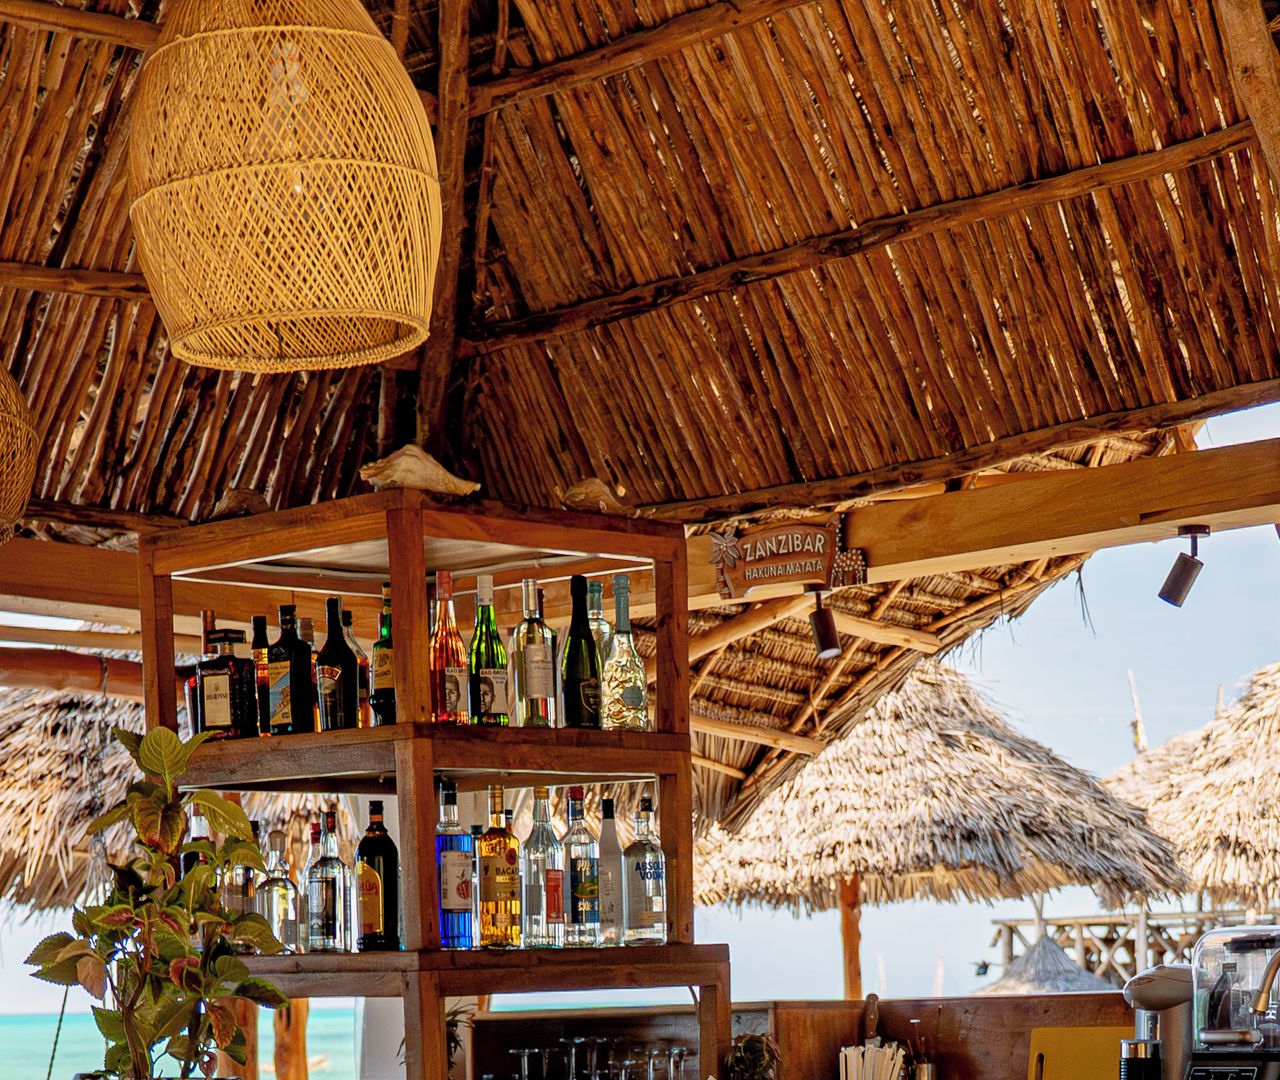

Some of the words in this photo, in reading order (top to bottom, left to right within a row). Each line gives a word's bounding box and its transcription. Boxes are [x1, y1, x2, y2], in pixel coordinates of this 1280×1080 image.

[743, 534, 825, 562] ZANZIBAR
[745, 563, 784, 580] HAKUNA
[786, 559, 823, 575] MATATA
